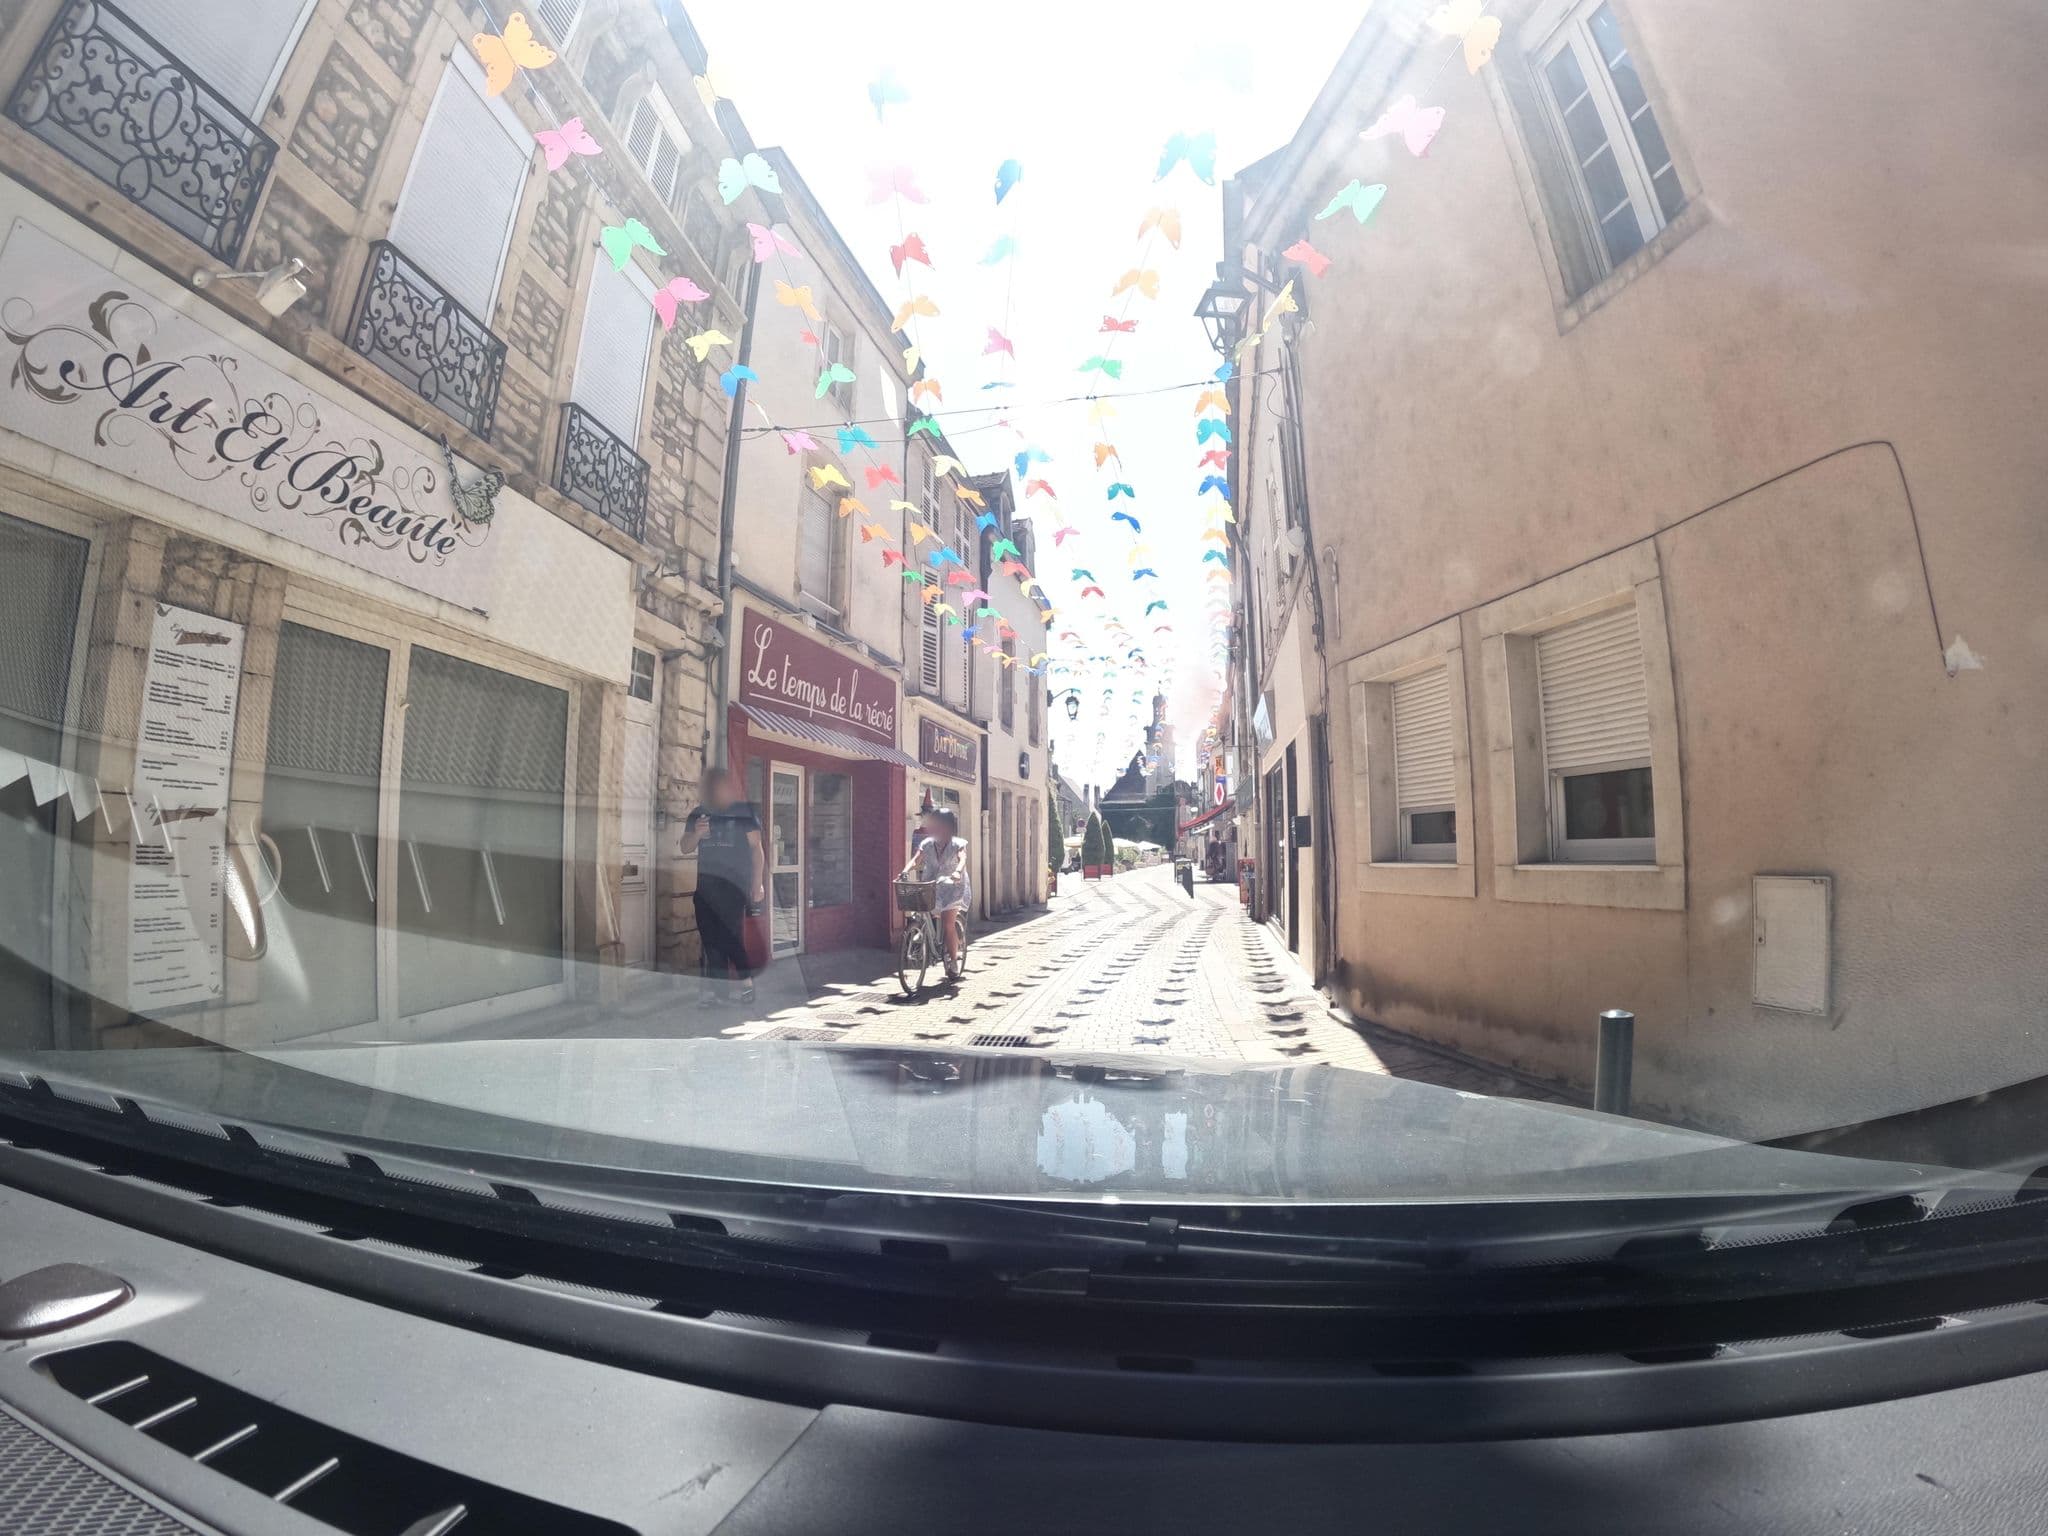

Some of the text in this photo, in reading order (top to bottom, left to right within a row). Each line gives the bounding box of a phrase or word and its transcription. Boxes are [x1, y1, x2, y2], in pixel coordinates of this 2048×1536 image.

[60, 353, 461, 554] Art Et Beauté
[748, 624, 893, 731] Le temps de la récré
